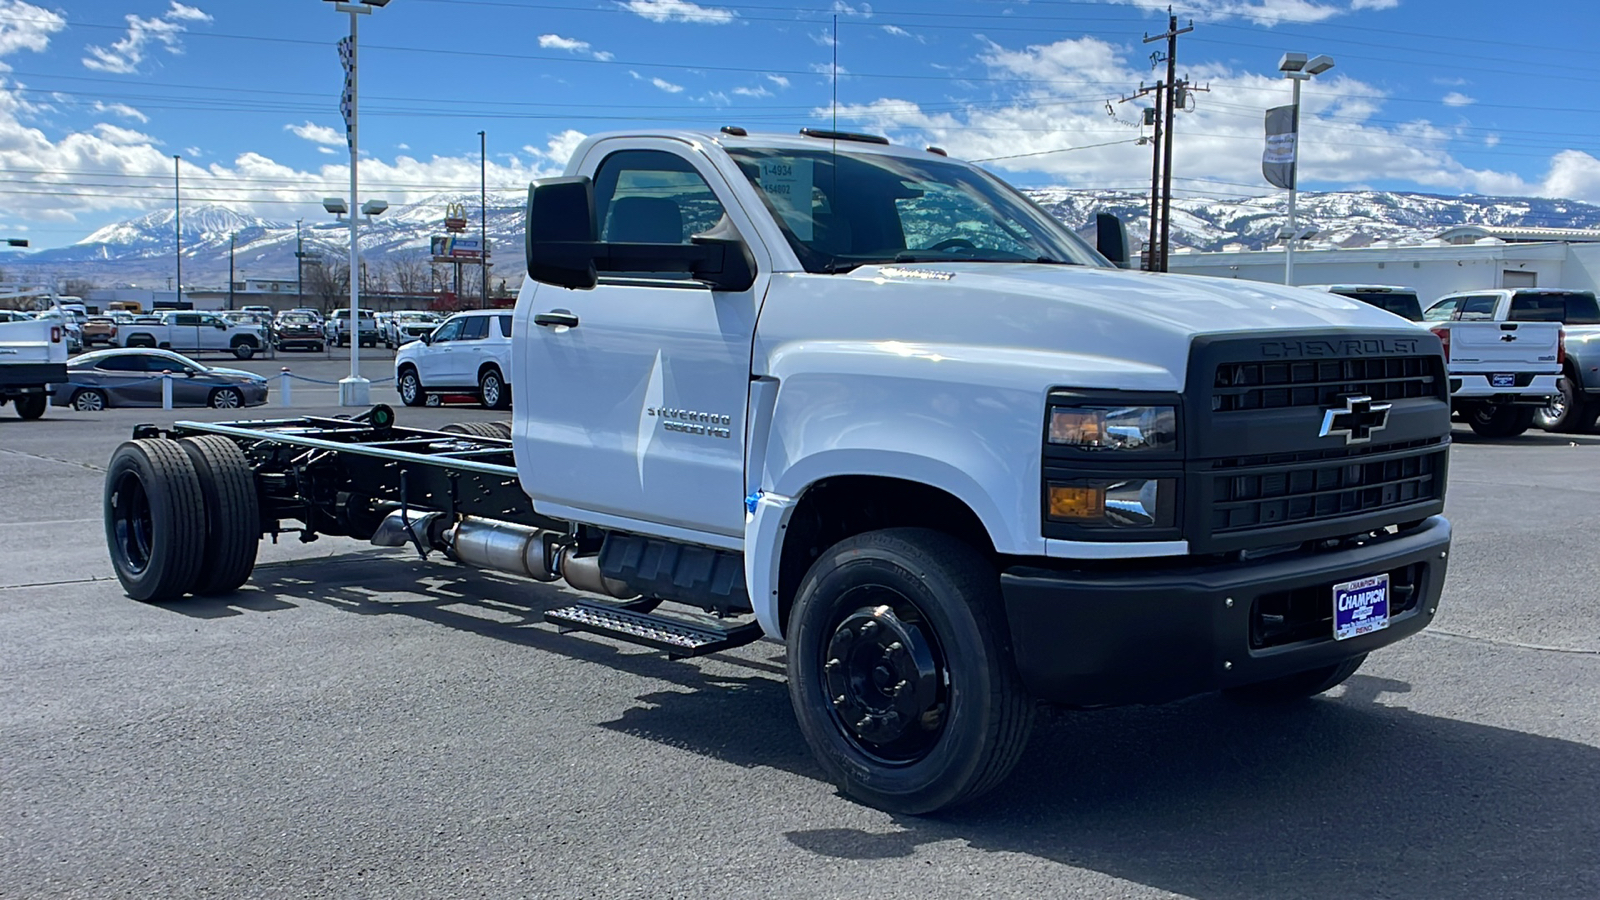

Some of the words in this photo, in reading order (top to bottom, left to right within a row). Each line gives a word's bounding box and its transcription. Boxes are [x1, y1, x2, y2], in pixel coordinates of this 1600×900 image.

[763, 164, 792, 176] 1-4934
[1260, 338, 1419, 358] CHEVROLET
[647, 406, 731, 426] SILVERADO
[706, 425, 731, 439] HD
[1355, 625, 1373, 635] RENO
